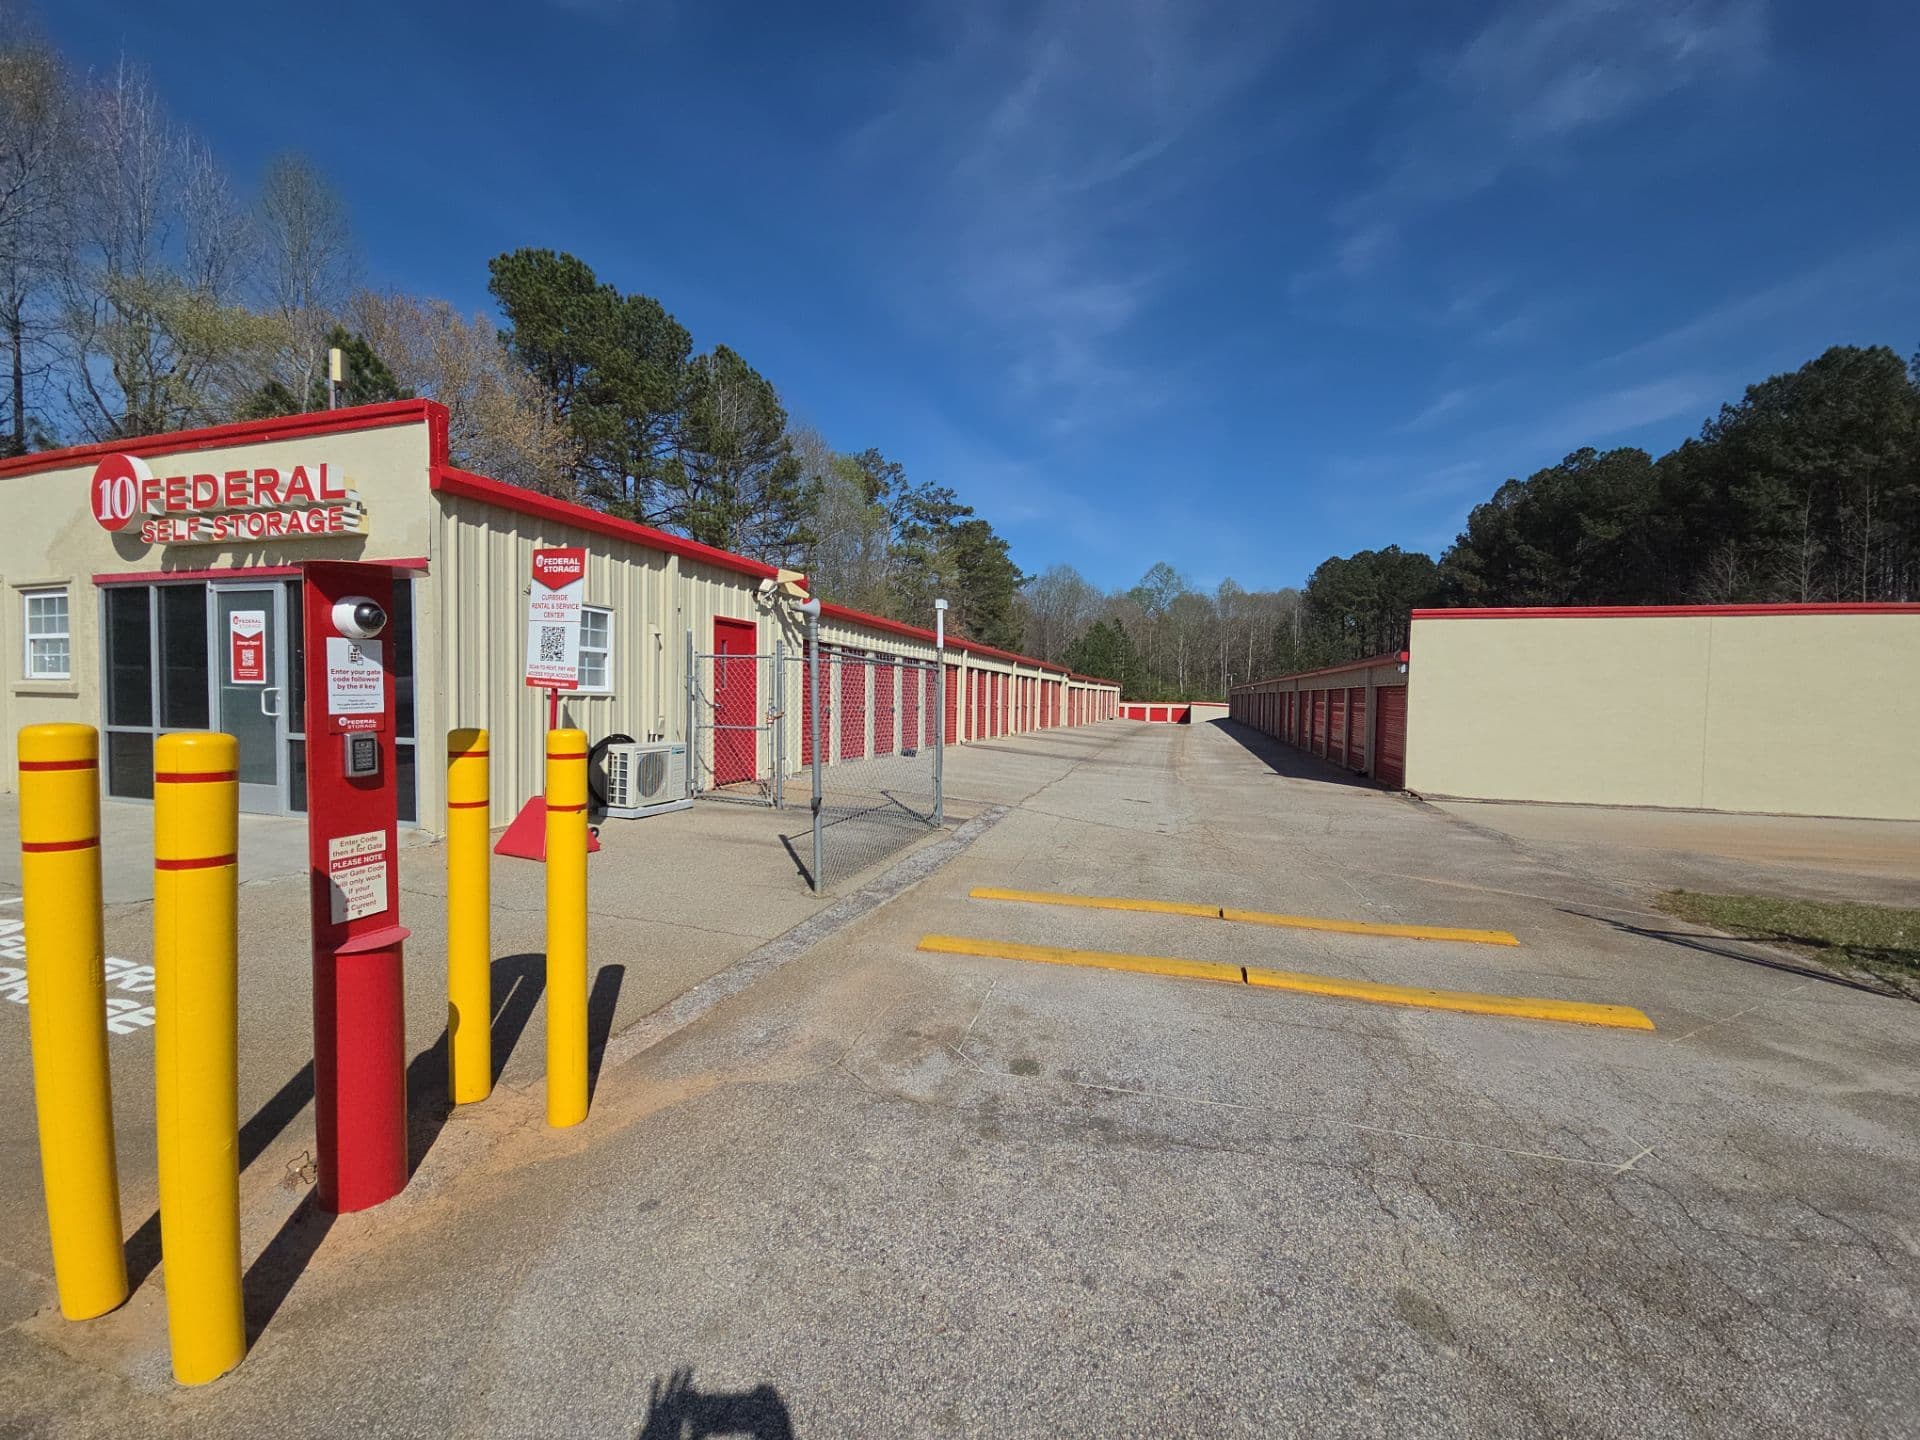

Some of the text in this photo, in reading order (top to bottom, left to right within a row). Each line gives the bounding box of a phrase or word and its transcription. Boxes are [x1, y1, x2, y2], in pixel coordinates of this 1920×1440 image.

[98, 463, 346, 521] 10 FEDERAL
[141, 506, 345, 543] SELF STORAGE
[340, 836, 378, 848] Enter Code
[332, 848, 348, 858] then
[332, 854, 383, 870] PLEASE NOTE
[332, 872, 348, 880] Your
[368, 864, 384, 873] Code
[336, 874, 382, 888] will only work
[355, 884, 370, 894] your
[345, 892, 374, 904] Account
[351, 900, 376, 911] Current
